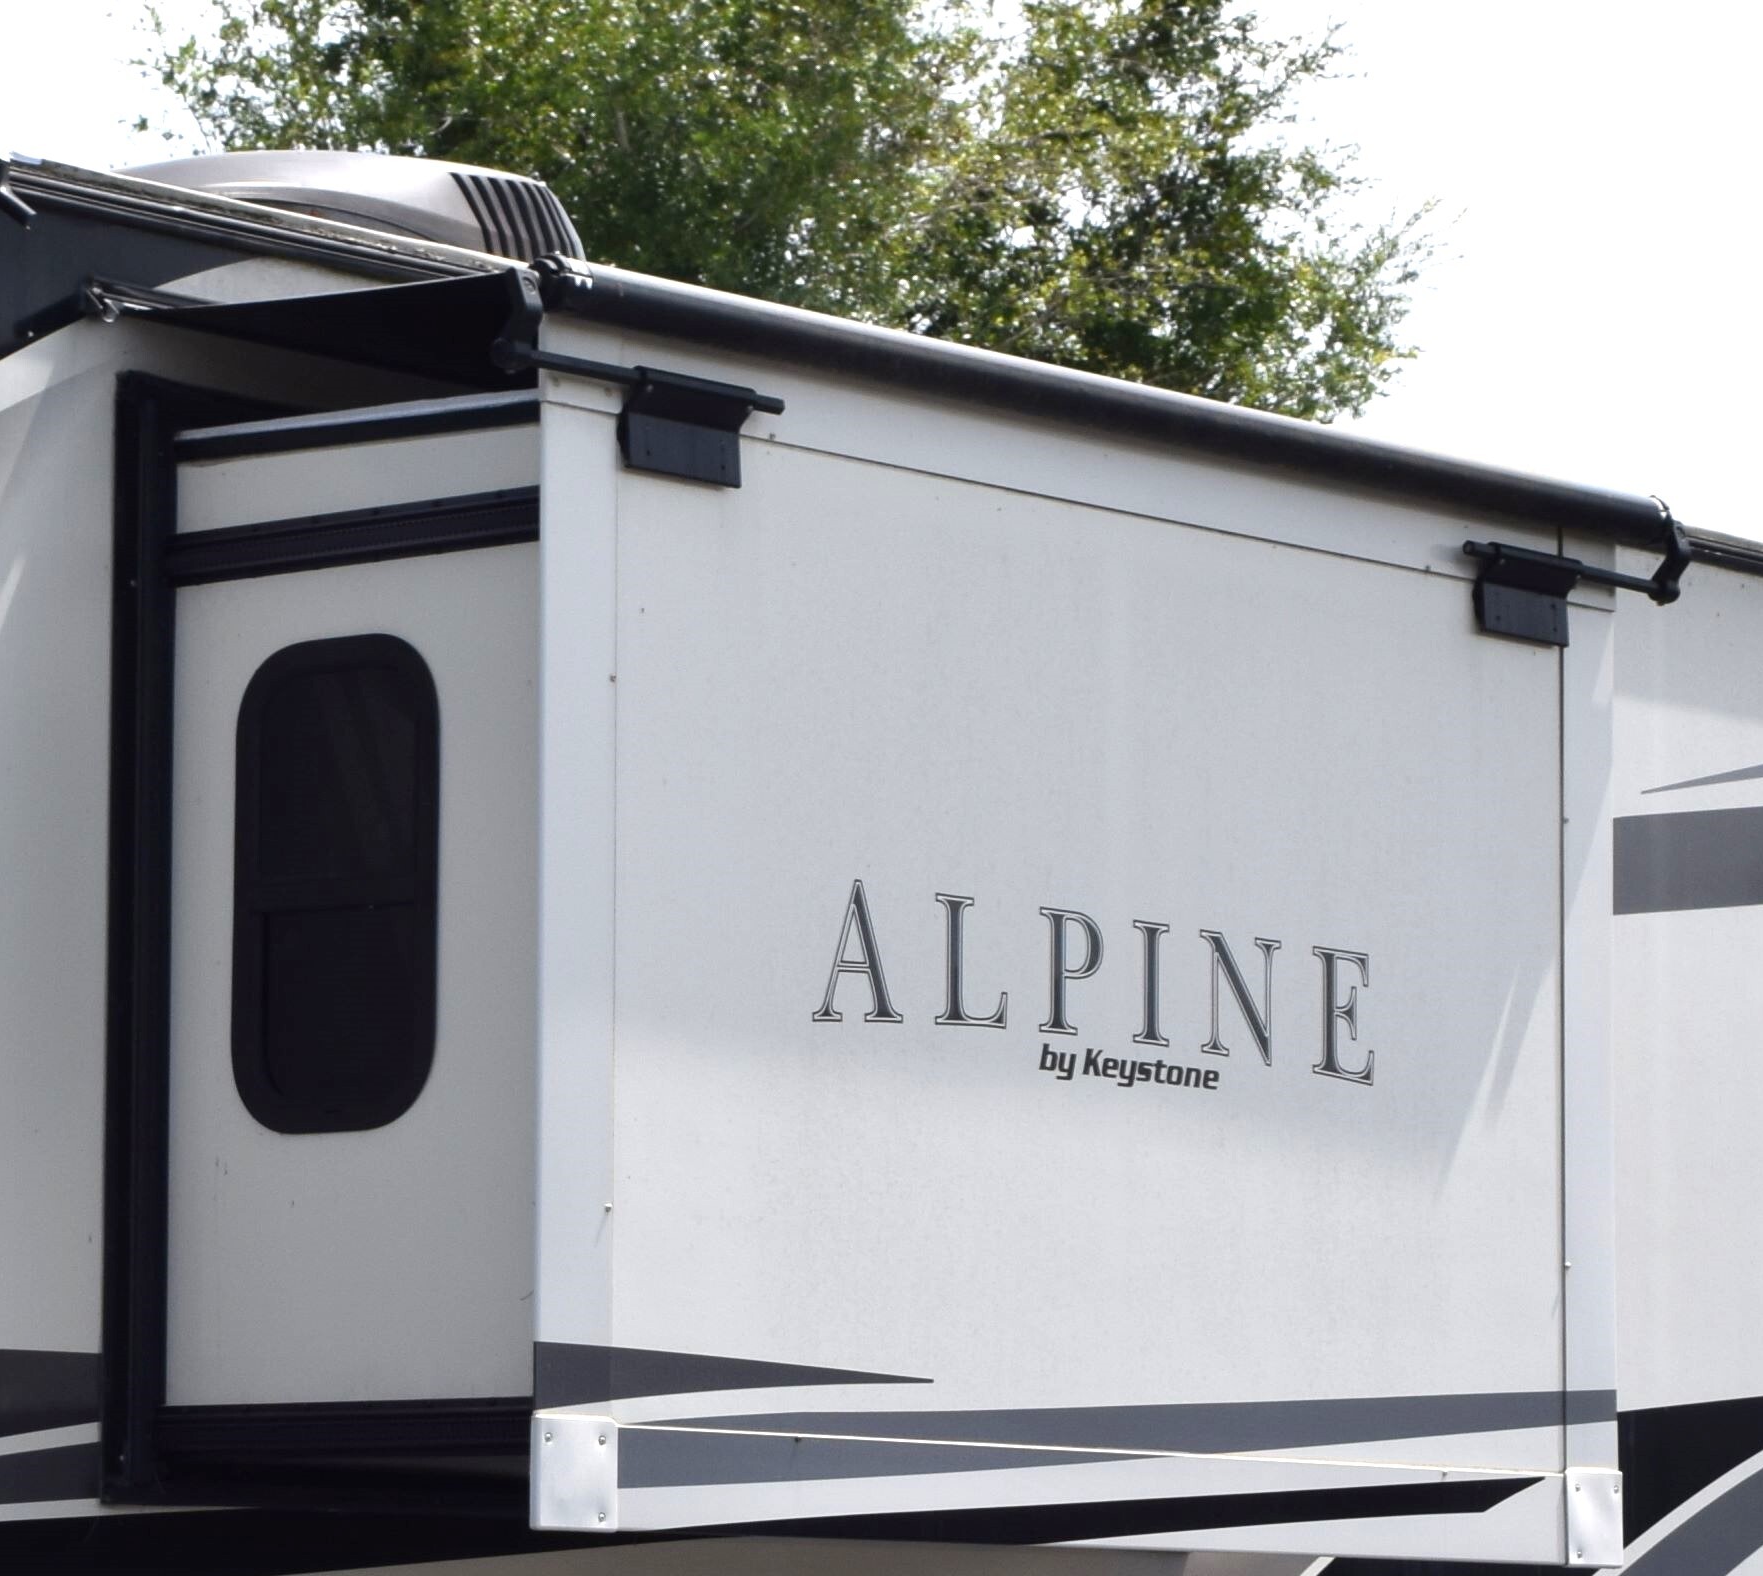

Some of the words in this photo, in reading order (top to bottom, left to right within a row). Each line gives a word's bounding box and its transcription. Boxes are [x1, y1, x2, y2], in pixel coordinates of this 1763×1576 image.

[811, 878, 1375, 1086] ALPINE
[1038, 1043, 1077, 1081] by
[1081, 1048, 1220, 1090] Keystone
